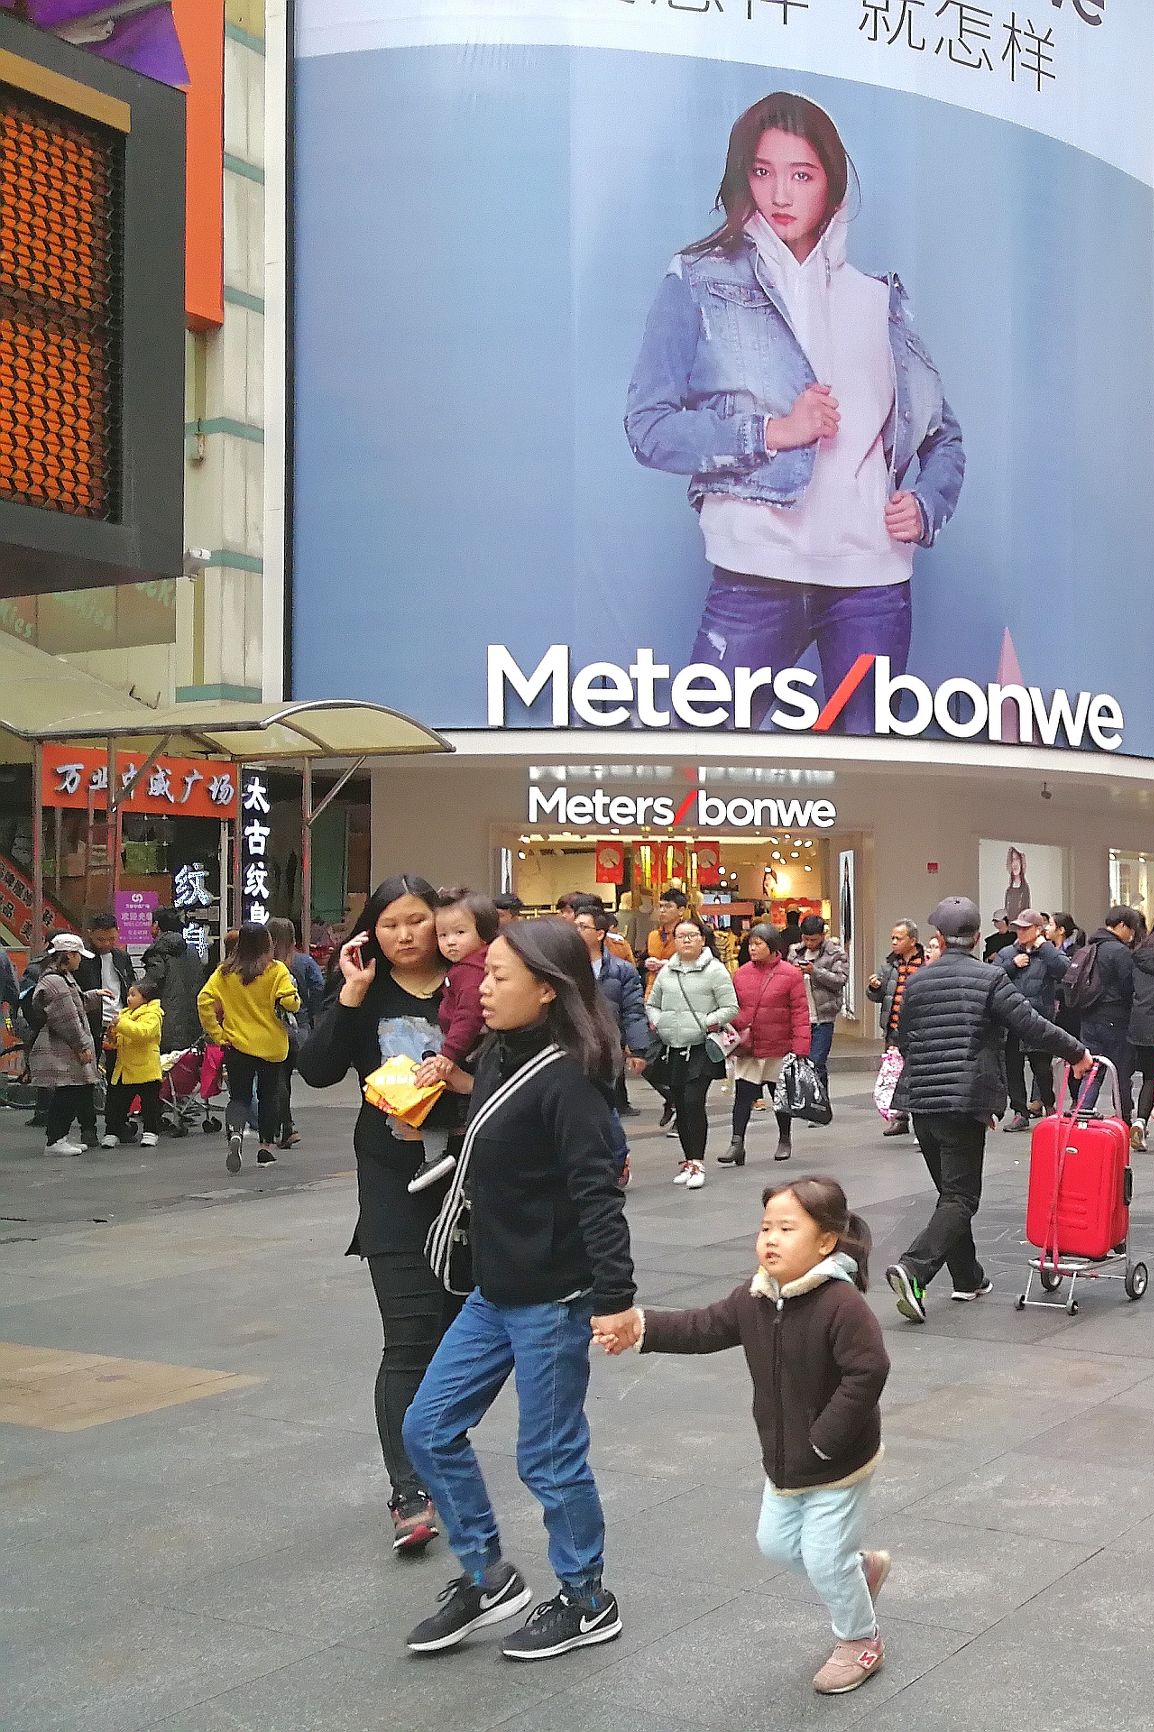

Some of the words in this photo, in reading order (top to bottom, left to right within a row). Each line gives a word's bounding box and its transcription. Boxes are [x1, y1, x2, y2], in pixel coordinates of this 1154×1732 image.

[858, 0, 1056, 92] 就怎样
[486, 643, 1124, 751] Meters/bonwe
[528, 786, 836, 828] Meters/bonwe
